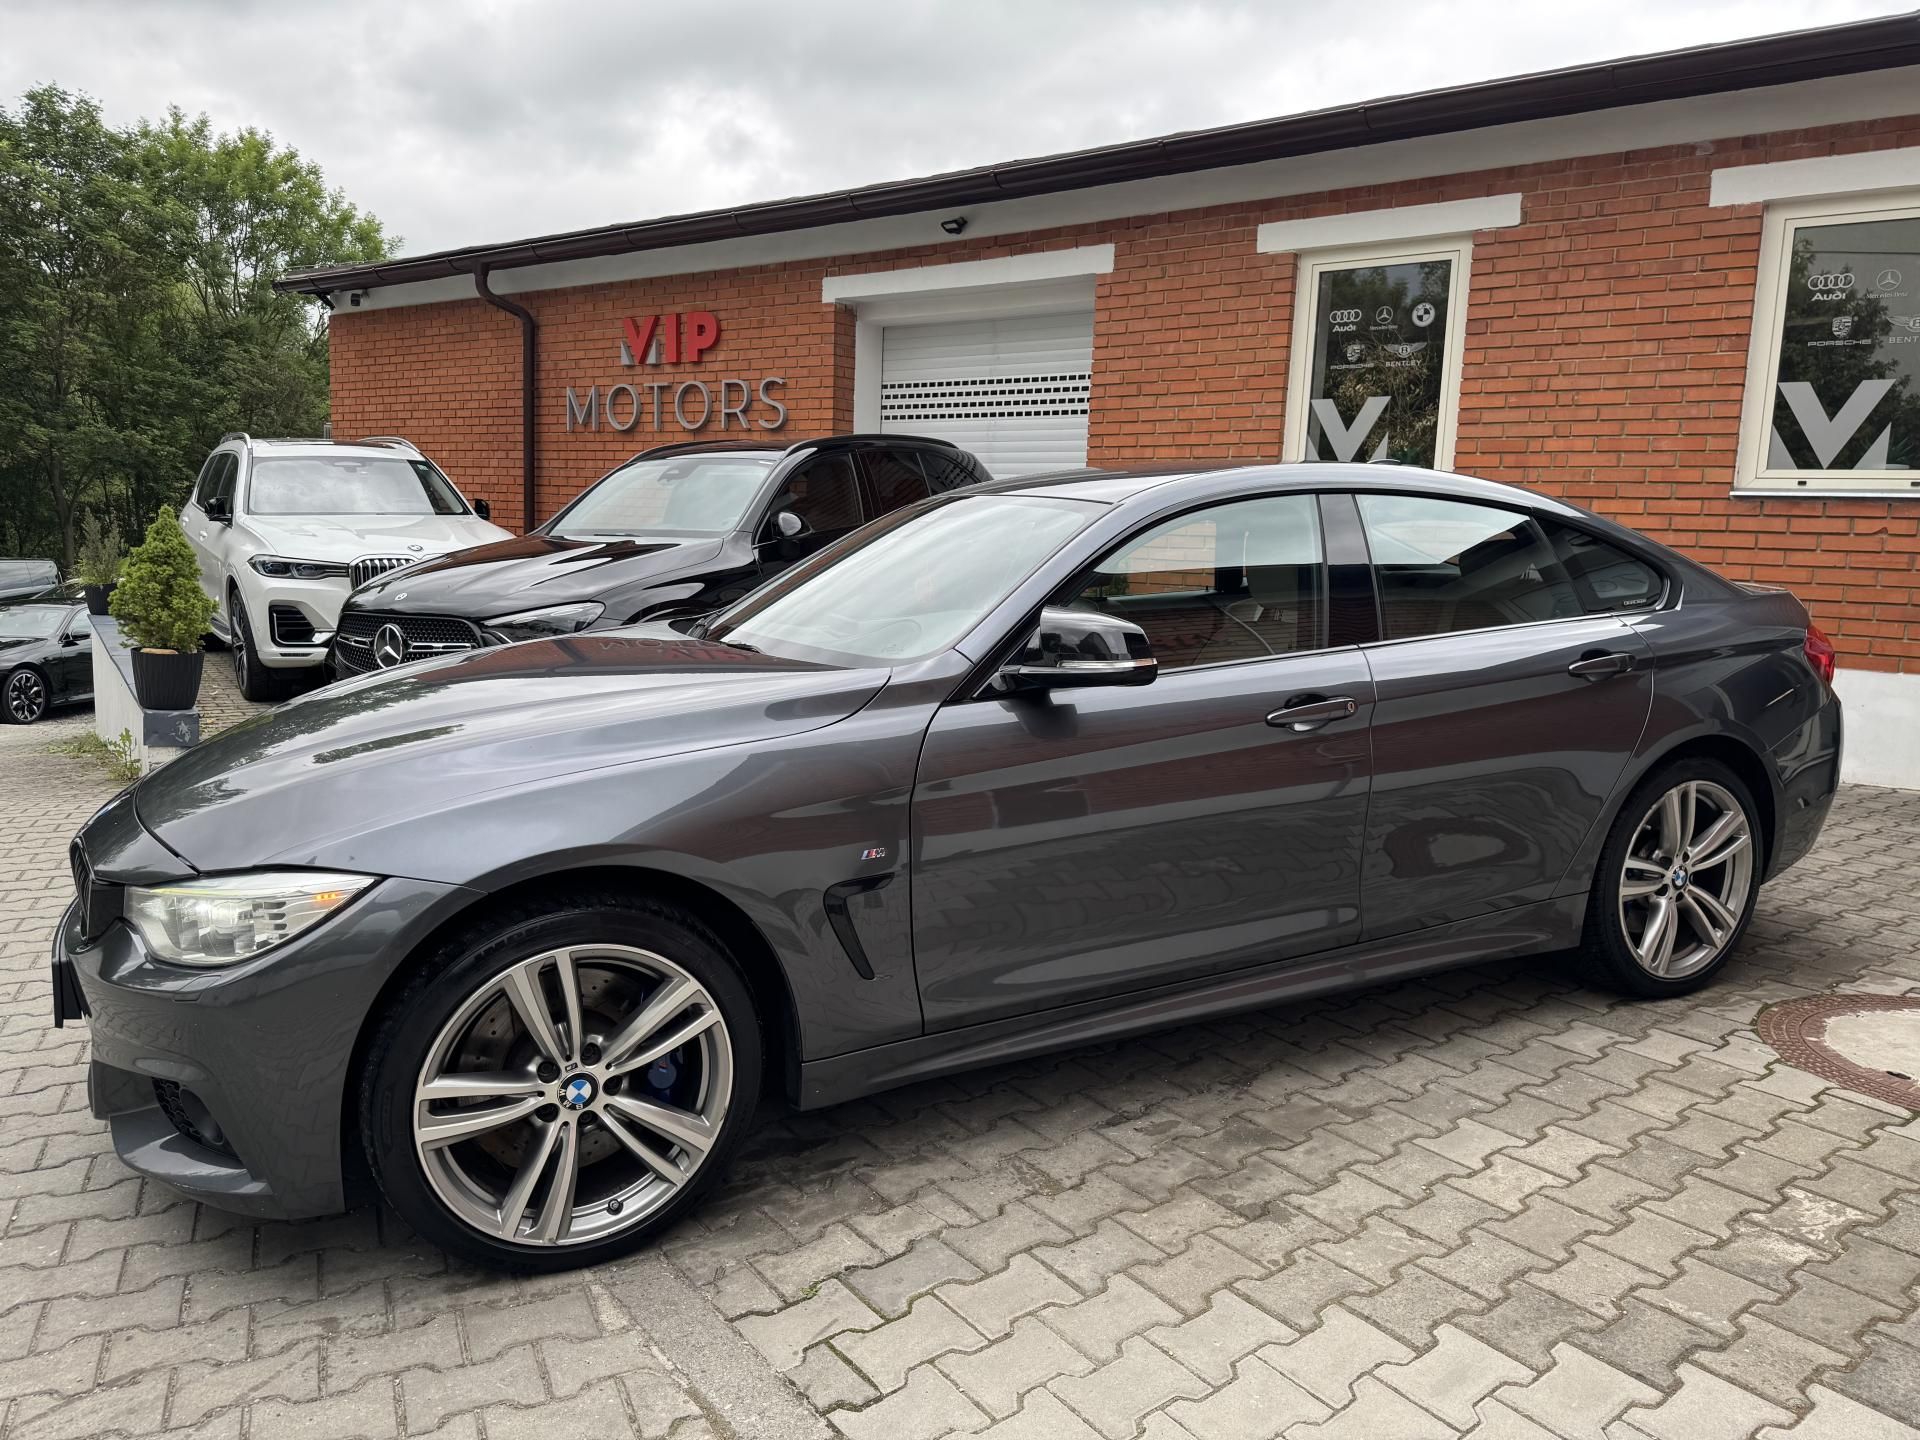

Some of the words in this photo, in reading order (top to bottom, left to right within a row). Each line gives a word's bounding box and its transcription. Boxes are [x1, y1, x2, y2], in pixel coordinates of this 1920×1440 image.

[1811, 291, 1846, 301] Audi
[1332, 324, 1356, 333] Audi
[621, 311, 722, 366] VIP
[1807, 339, 1872, 347] PORSCHE
[1385, 359, 1421, 368] BENTLEY
[566, 376, 788, 432] MOTORS
